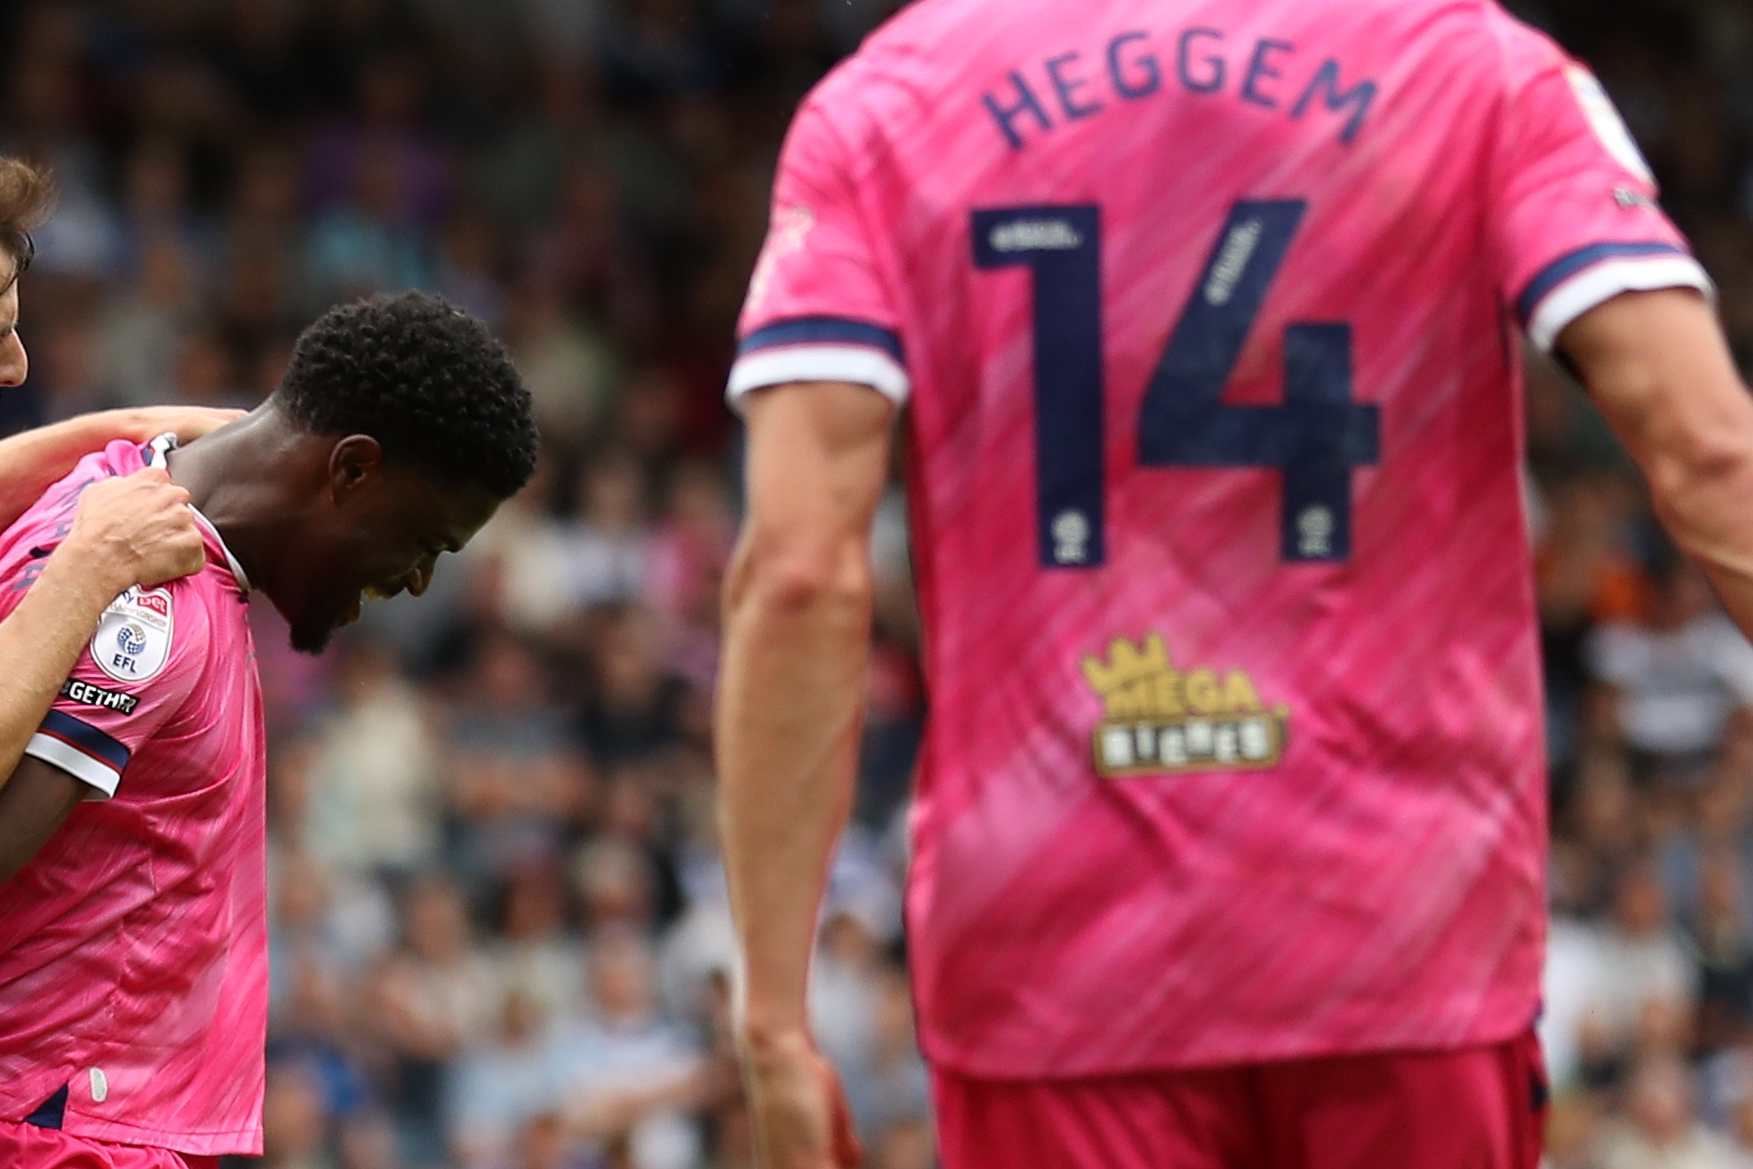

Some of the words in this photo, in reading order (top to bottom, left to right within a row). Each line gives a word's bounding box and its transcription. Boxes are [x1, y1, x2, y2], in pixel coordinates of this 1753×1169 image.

[980, 25, 1381, 149] HEGGEM
[969, 198, 1381, 568] 14
[112, 652, 137, 674] EFL
[1106, 667, 1263, 716] MEGA
